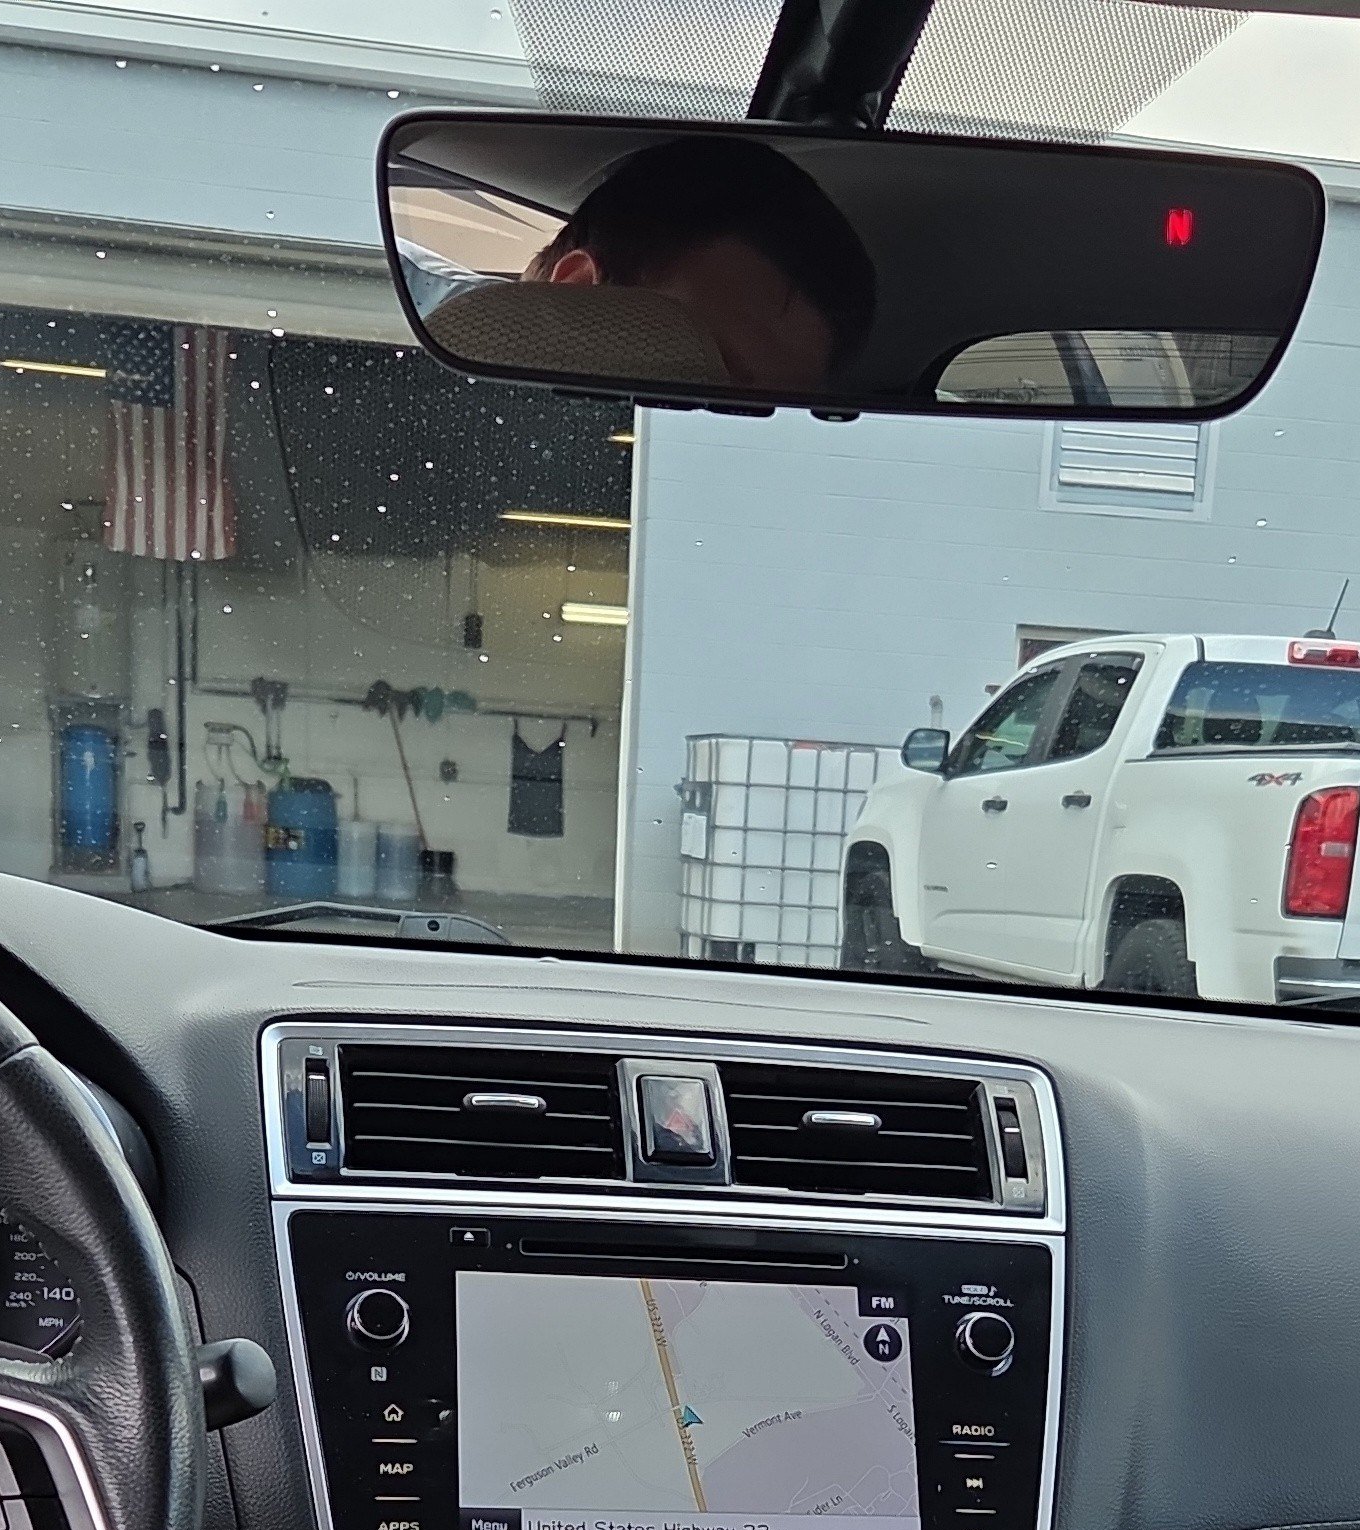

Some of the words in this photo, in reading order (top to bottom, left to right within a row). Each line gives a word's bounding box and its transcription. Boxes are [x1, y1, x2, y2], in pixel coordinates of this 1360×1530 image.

[1167, 209, 1192, 245] N
[14, 1252, 37, 1261] 200
[14, 1272, 37, 1282] 220
[9, 1291, 32, 1301] 240
[42, 1287, 74, 1300] 140
[871, 1296, 895, 1310] FM
[942, 1294, 1015, 1307] TUNE/SCROLL
[39, 1317, 64, 1328] MPH
[820, 1318, 844, 1348] Logan
[842, 1345, 861, 1366] Blvd
[878, 1343, 889, 1355] N
[742, 1415, 782, 1439] Vermont
[784, 1409, 802, 1421] Ave
[952, 1424, 995, 1437] RADIO
[379, 1463, 414, 1475] MAP
[509, 1466, 554, 1493] Ferguson
[554, 1452, 586, 1473] Valley
[584, 1443, 600, 1458] Rd
